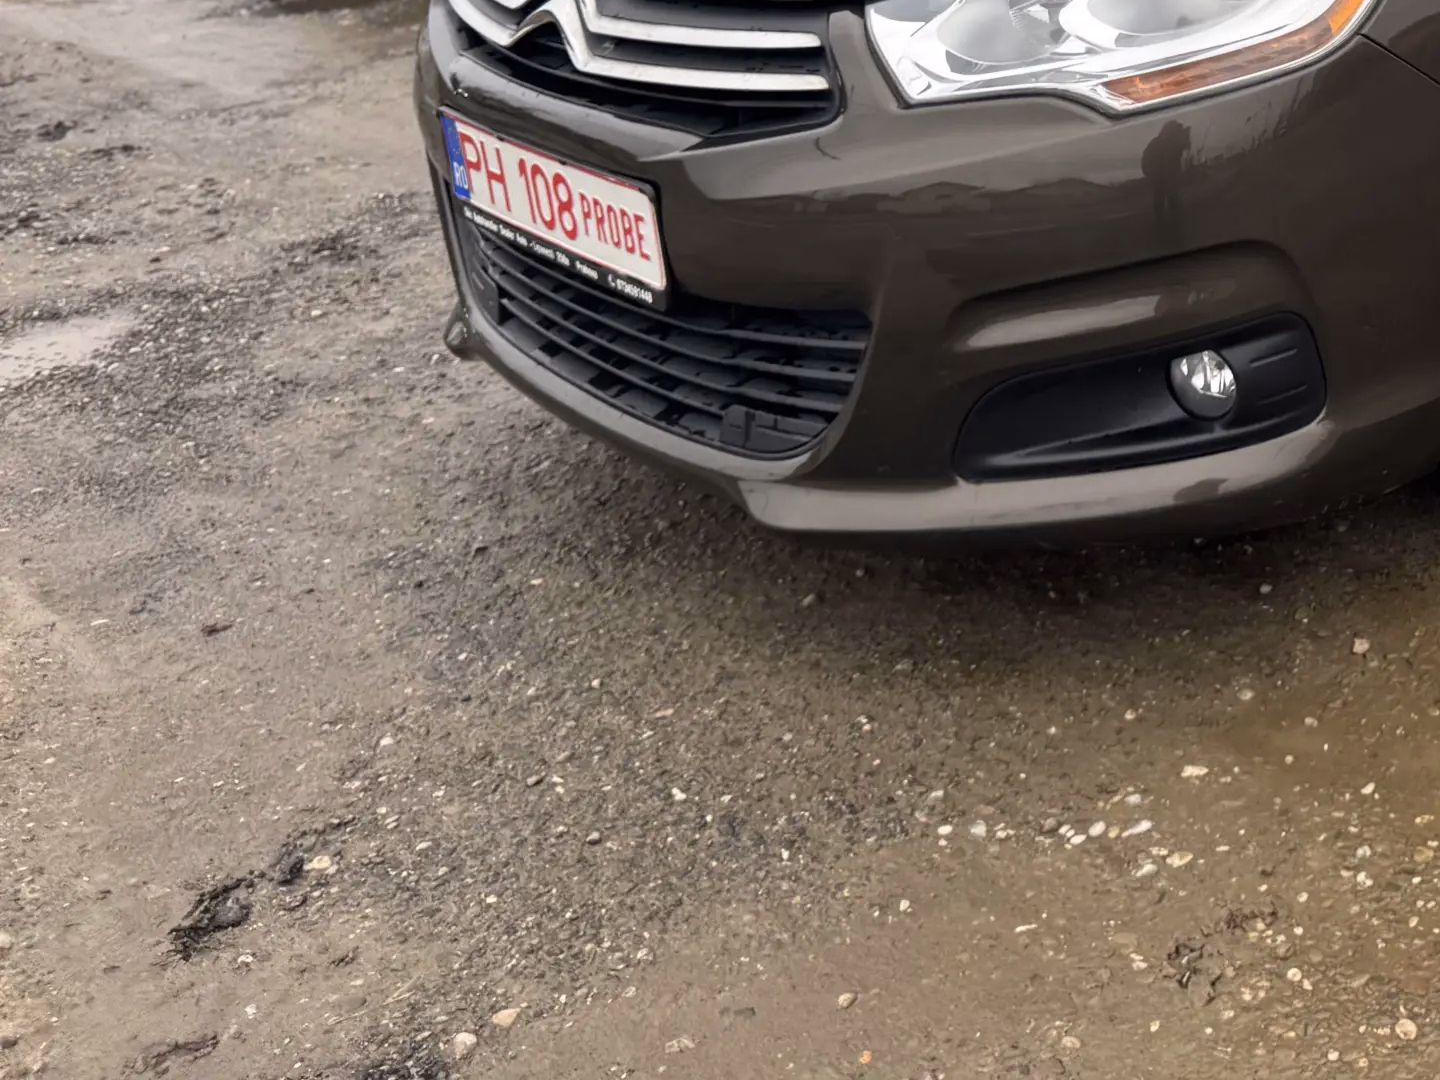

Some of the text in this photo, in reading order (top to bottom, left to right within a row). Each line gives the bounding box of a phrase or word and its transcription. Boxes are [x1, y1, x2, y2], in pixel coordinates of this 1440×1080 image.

[452, 161, 469, 190] RO
[459, 131, 511, 213] PH
[518, 158, 578, 241] 108
[578, 191, 653, 261] PROBE
